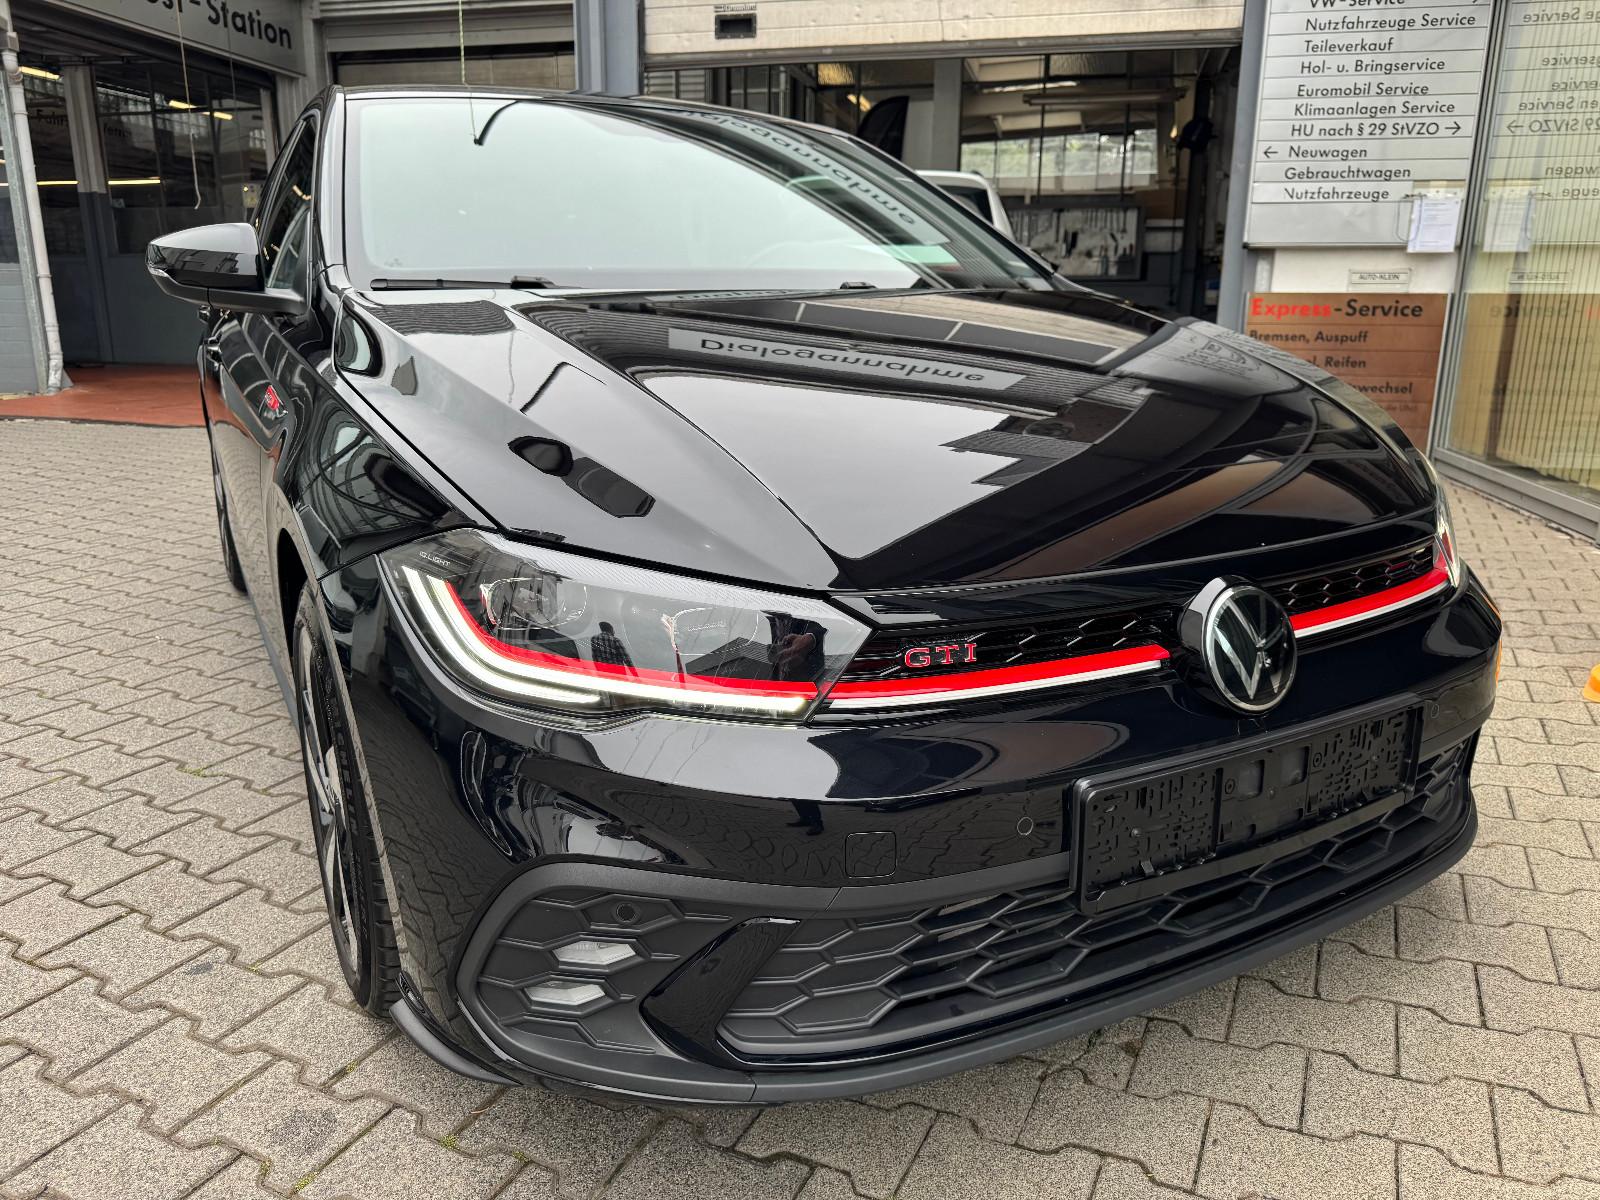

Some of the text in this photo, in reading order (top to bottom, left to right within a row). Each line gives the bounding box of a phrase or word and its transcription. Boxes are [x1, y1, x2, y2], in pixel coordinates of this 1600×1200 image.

[1305, 13, 1476, 31] Nutzfahrzeuge Service
[1304, 37, 1394, 53] Teileverkauf
[1300, 58, 1445, 75] Hol- u. Bringservice
[1297, 81, 1430, 98] Euromobil Service
[1294, 100, 1456, 118] Klimaanlagen Service
[1291, 122, 1440, 137] HU nach § 29 StVZO
[1288, 145, 1368, 161] Neuwagen
[1284, 165, 1411, 182] Gebrauchtwagen
[1250, 330, 1369, 345] Bremsen, Auspuff
[1324, 356, 1366, 369] Reifen
[904, 642, 978, 668] GTI
